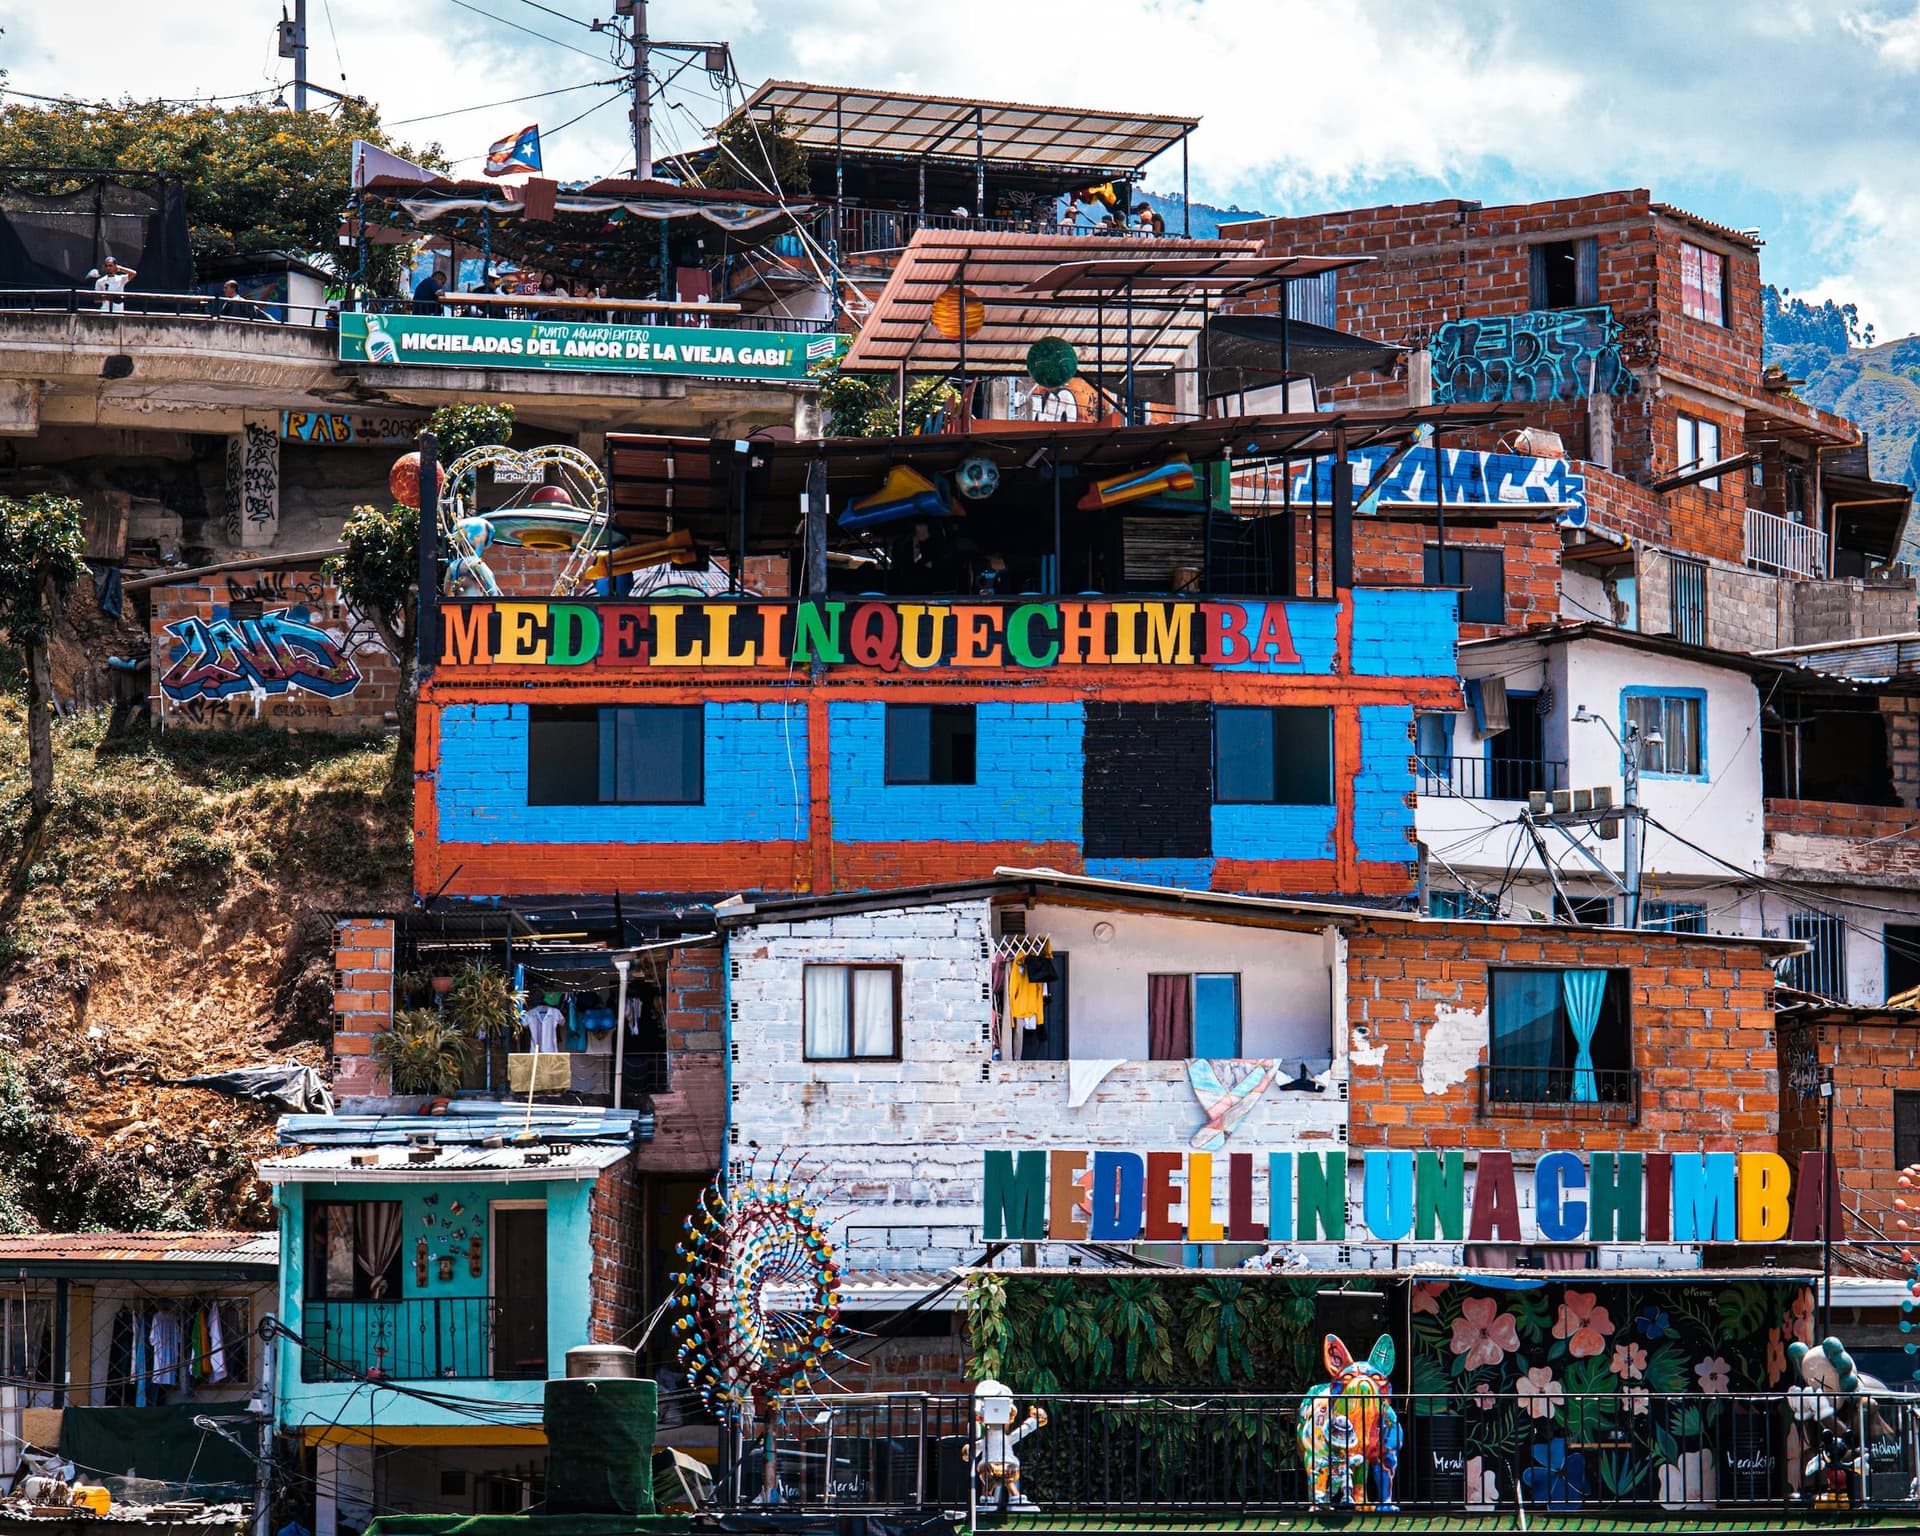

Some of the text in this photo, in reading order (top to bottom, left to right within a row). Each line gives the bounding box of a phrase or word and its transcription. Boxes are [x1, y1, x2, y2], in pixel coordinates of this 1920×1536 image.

[402, 332, 793, 367] MICHELADAS DEL AMOR DE LA VIEJA GABI!
[572, 326, 649, 343] AGUARDIENTERO
[983, 1150, 1847, 1242] MEDELLIN UNA CHIMBA
